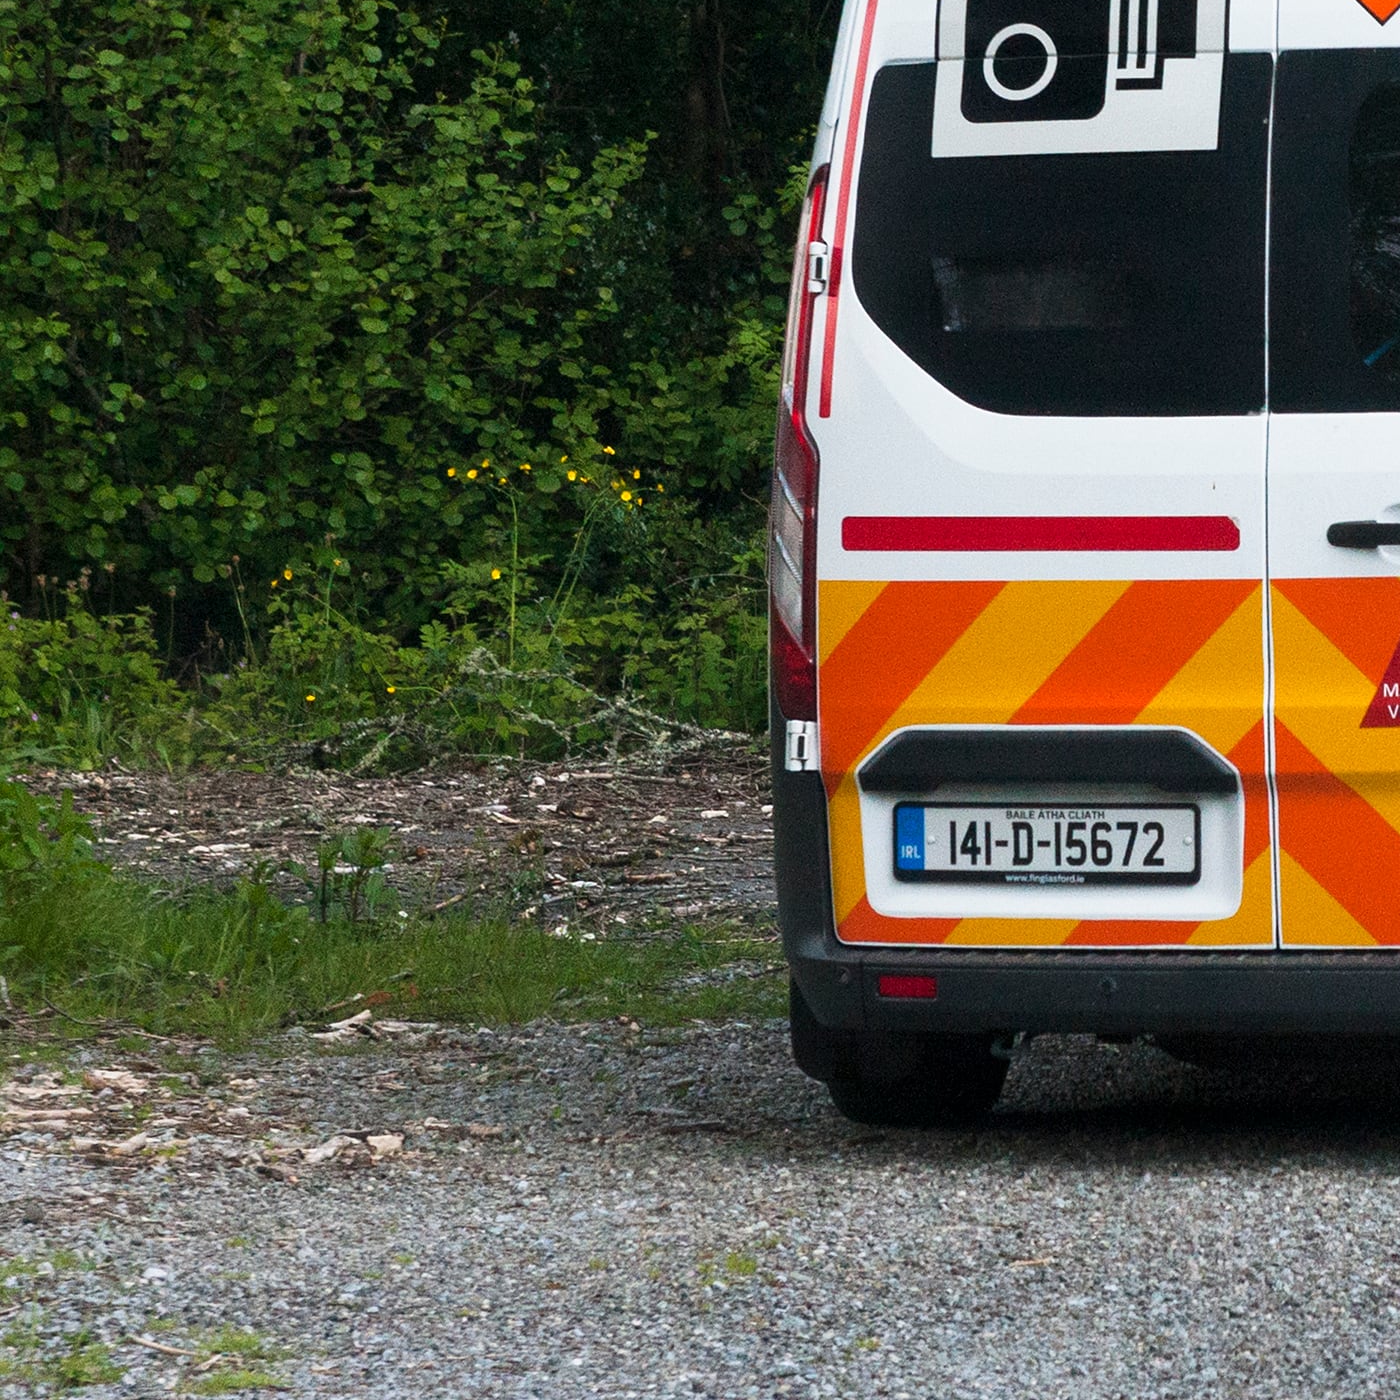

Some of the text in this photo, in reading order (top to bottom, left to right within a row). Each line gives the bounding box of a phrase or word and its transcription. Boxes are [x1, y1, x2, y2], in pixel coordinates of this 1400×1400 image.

[1006, 810, 1035, 820] BAILE
[1068, 810, 1105, 820] CLIATH
[949, 820, 1165, 867] 141-D-15672
[901, 845, 921, 859] IRL
